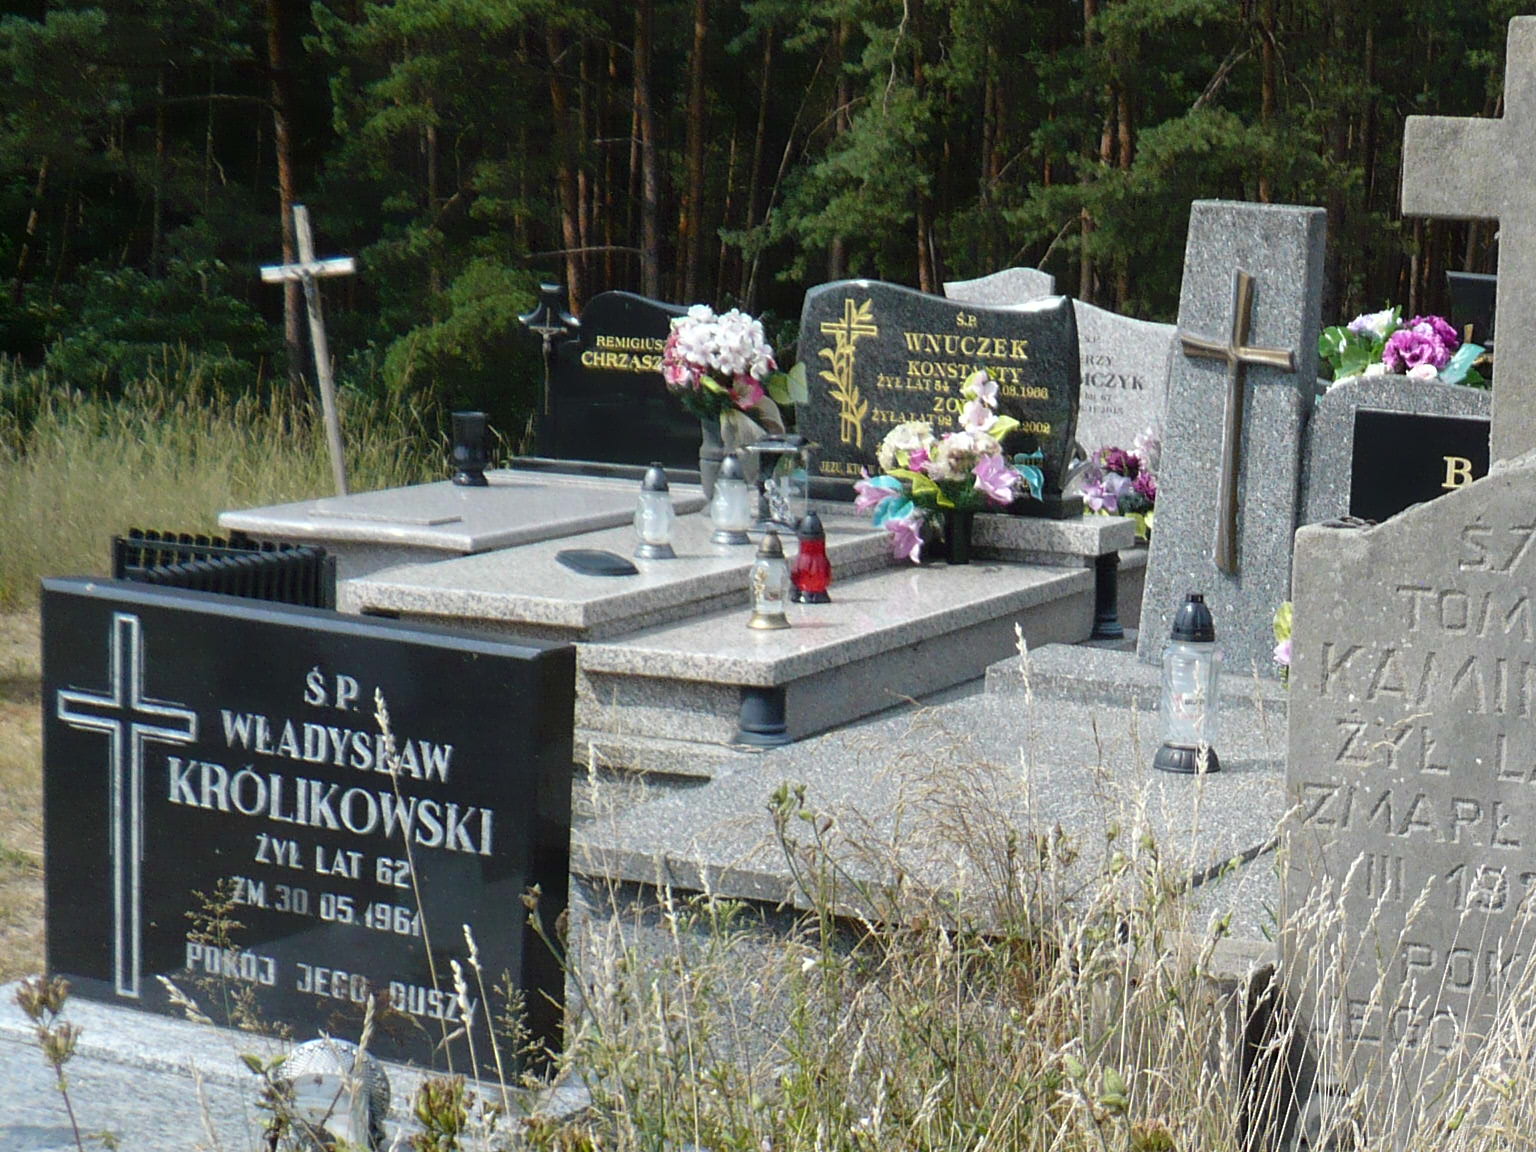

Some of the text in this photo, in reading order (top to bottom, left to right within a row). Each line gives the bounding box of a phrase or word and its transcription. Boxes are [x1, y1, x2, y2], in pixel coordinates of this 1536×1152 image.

[581, 351, 664, 373] CHRZĄSZ
[596, 335, 667, 351] REMIGIUS
[904, 332, 1029, 360] WNUCZEK
[220, 708, 454, 784] WŁADYSŁAW
[1335, 708, 1451, 776] ŻYŁ
[167, 755, 495, 857] KRÓLIKOWSKI
[254, 832, 413, 889] ŻYŁ LAT 62
[185, 940, 278, 987] POKÓJ
